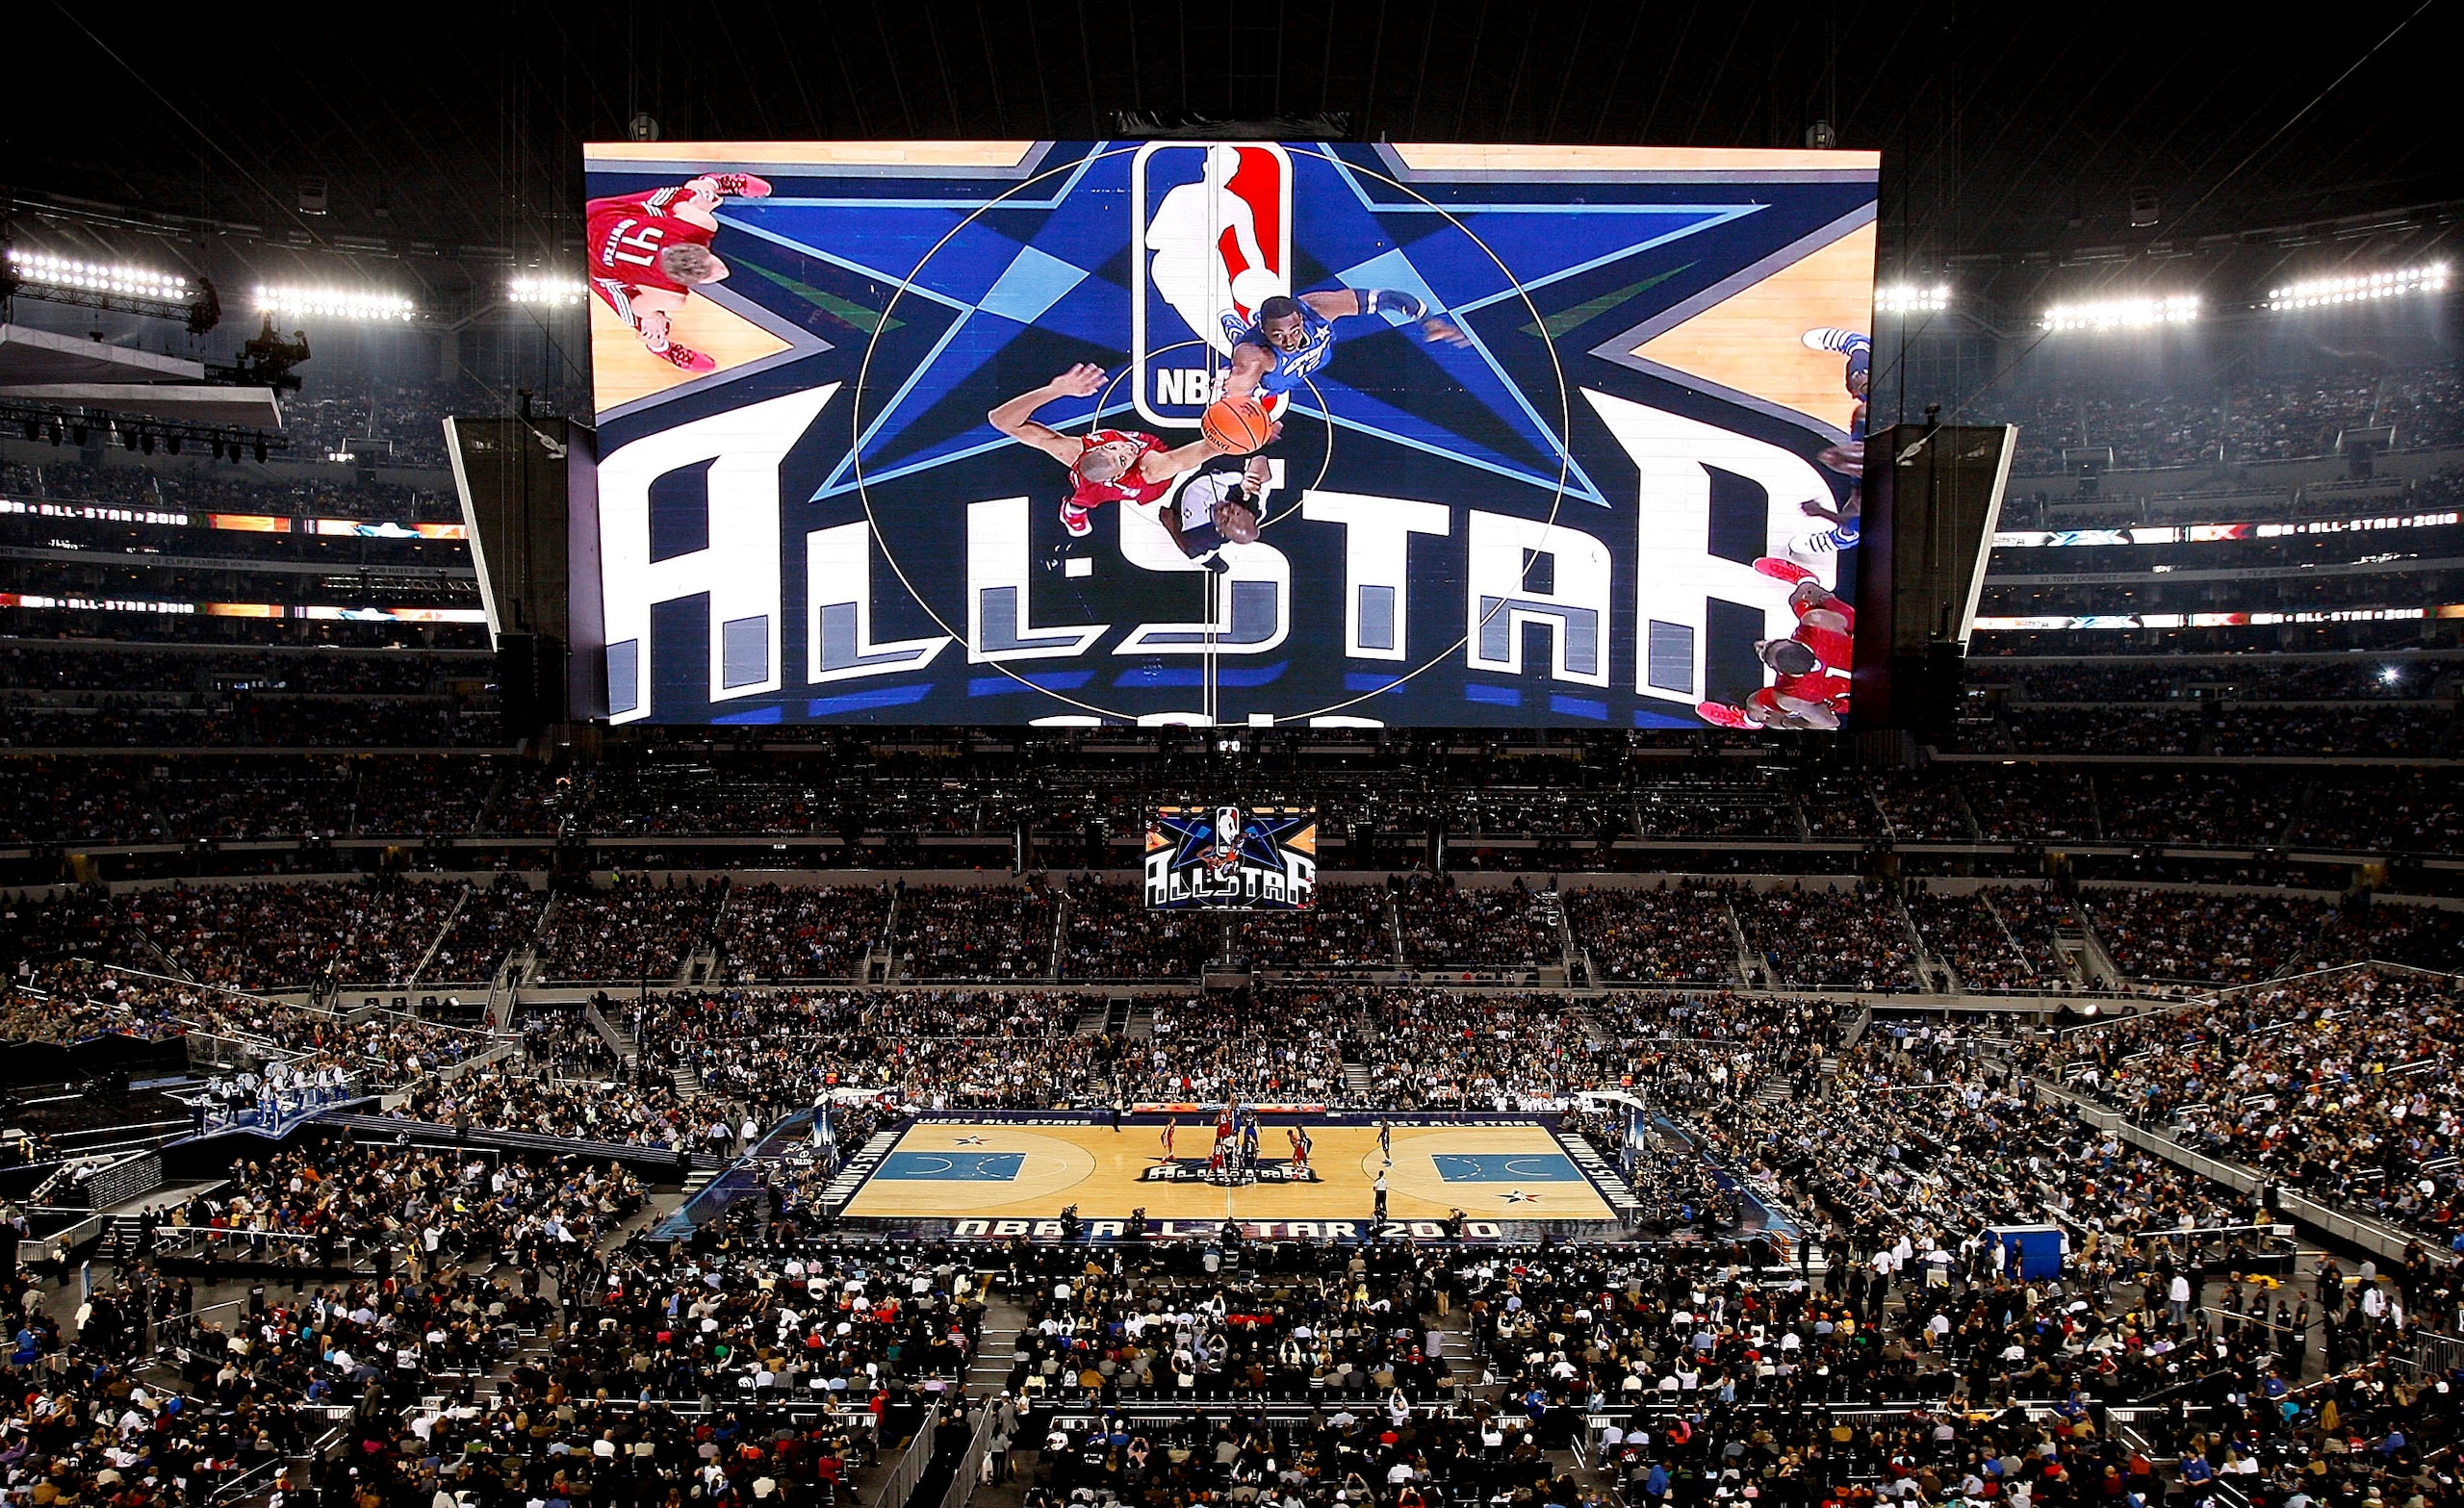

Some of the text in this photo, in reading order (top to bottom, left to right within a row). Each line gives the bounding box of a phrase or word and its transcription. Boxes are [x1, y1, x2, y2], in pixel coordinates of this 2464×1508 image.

[615, 226, 664, 267] 41
[39, 503, 133, 523] ALL-STAR
[145, 511, 189, 525] 2010
[2308, 517, 2400, 534] ALL-STAR
[2412, 512, 2459, 527] 2010
[67, 599, 146, 612] ALL-STAR
[157, 602, 194, 614] 2010
[2384, 608, 2424, 621] 2010
[953, 1220, 1063, 1237] NBA
[1378, 1221, 1502, 1238] 200
